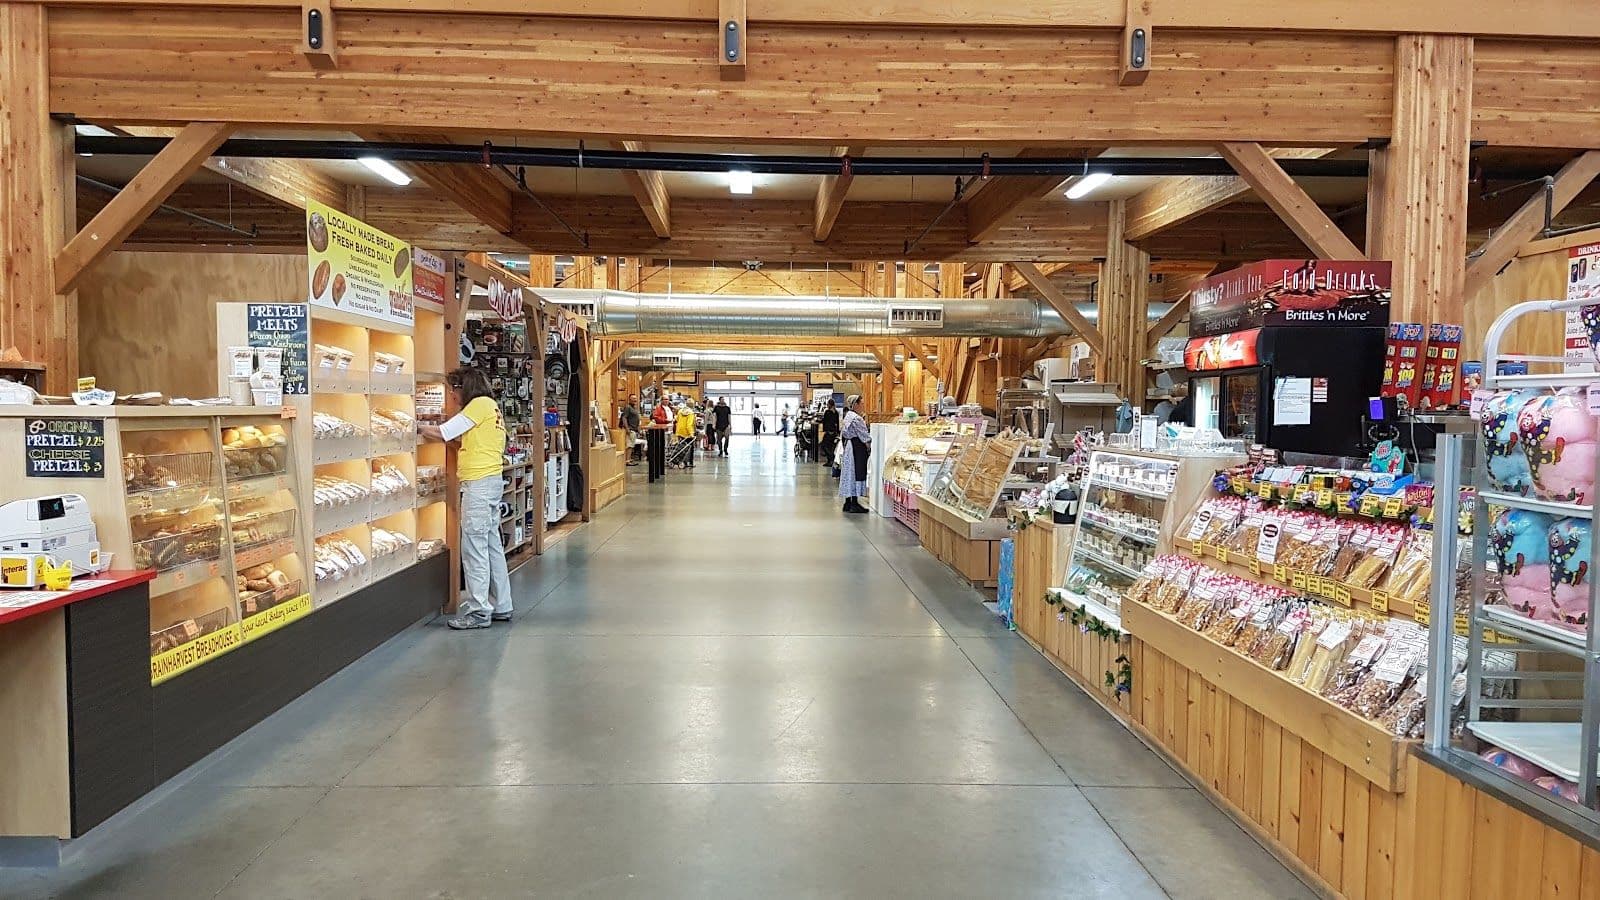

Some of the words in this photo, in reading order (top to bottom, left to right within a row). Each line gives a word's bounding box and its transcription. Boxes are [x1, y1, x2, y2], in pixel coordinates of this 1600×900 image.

[328, 212, 356, 237] LOCALLY
[358, 228, 374, 244] MADE
[376, 236, 394, 252] BREAD
[332, 230, 354, 250] FRESH
[356, 242, 376, 258] BAKED
[376, 250, 393, 264] DAILY
[1283, 270, 1316, 290] Cold
[1326, 270, 1375, 290] Drinks
[1192, 282, 1224, 306] Thirsty?
[250, 306, 304, 317] PRETZEL
[1286, 310, 1324, 320] Brittles
[256, 318, 298, 330] MELTS
[1398, 368, 1415, 382] 100
[1438, 372, 1454, 386] 112
[298, 382, 306, 394] 6
[26, 434, 77, 446] PRETZEL
[28, 449, 91, 460] CHEESE
[32, 460, 82, 472] PRETZEL
[2, 564, 28, 576] Interac
[286, 604, 298, 614] since
[196, 630, 234, 660] BREADHOUSE
